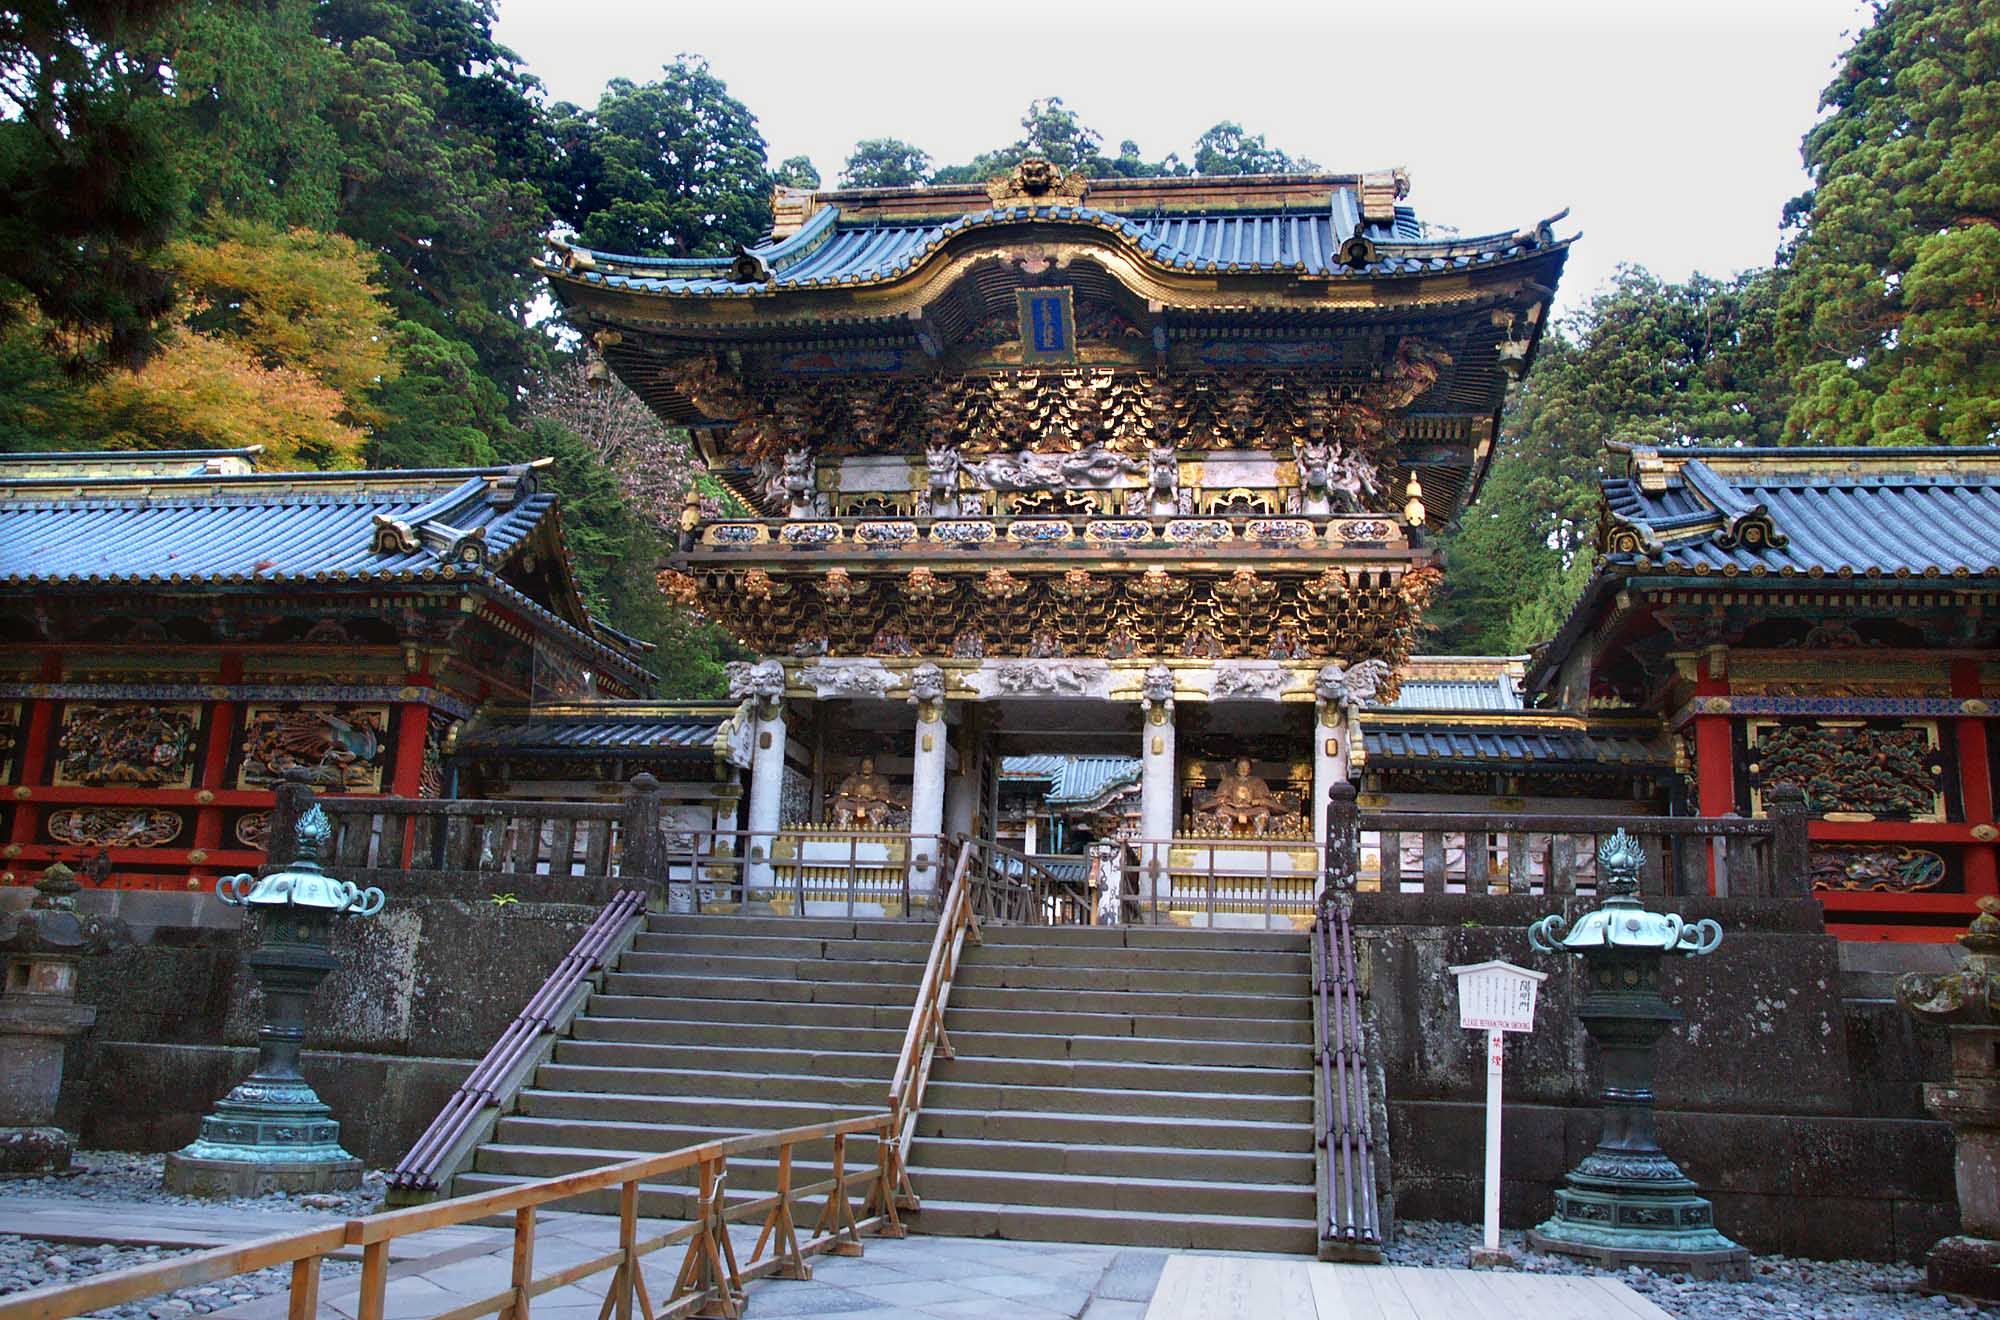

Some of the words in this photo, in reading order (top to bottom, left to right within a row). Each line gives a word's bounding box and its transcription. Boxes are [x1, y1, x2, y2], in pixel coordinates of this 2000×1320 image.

[1463, 1017, 1479, 1026] PLEASE
[1480, 1018, 1496, 1027] REFRAIN
[1497, 1019, 1510, 1028] FROM
[1511, 1020, 1530, 1029] SMOKING
[1492, 1036, 1502, 1066] 禁煙
